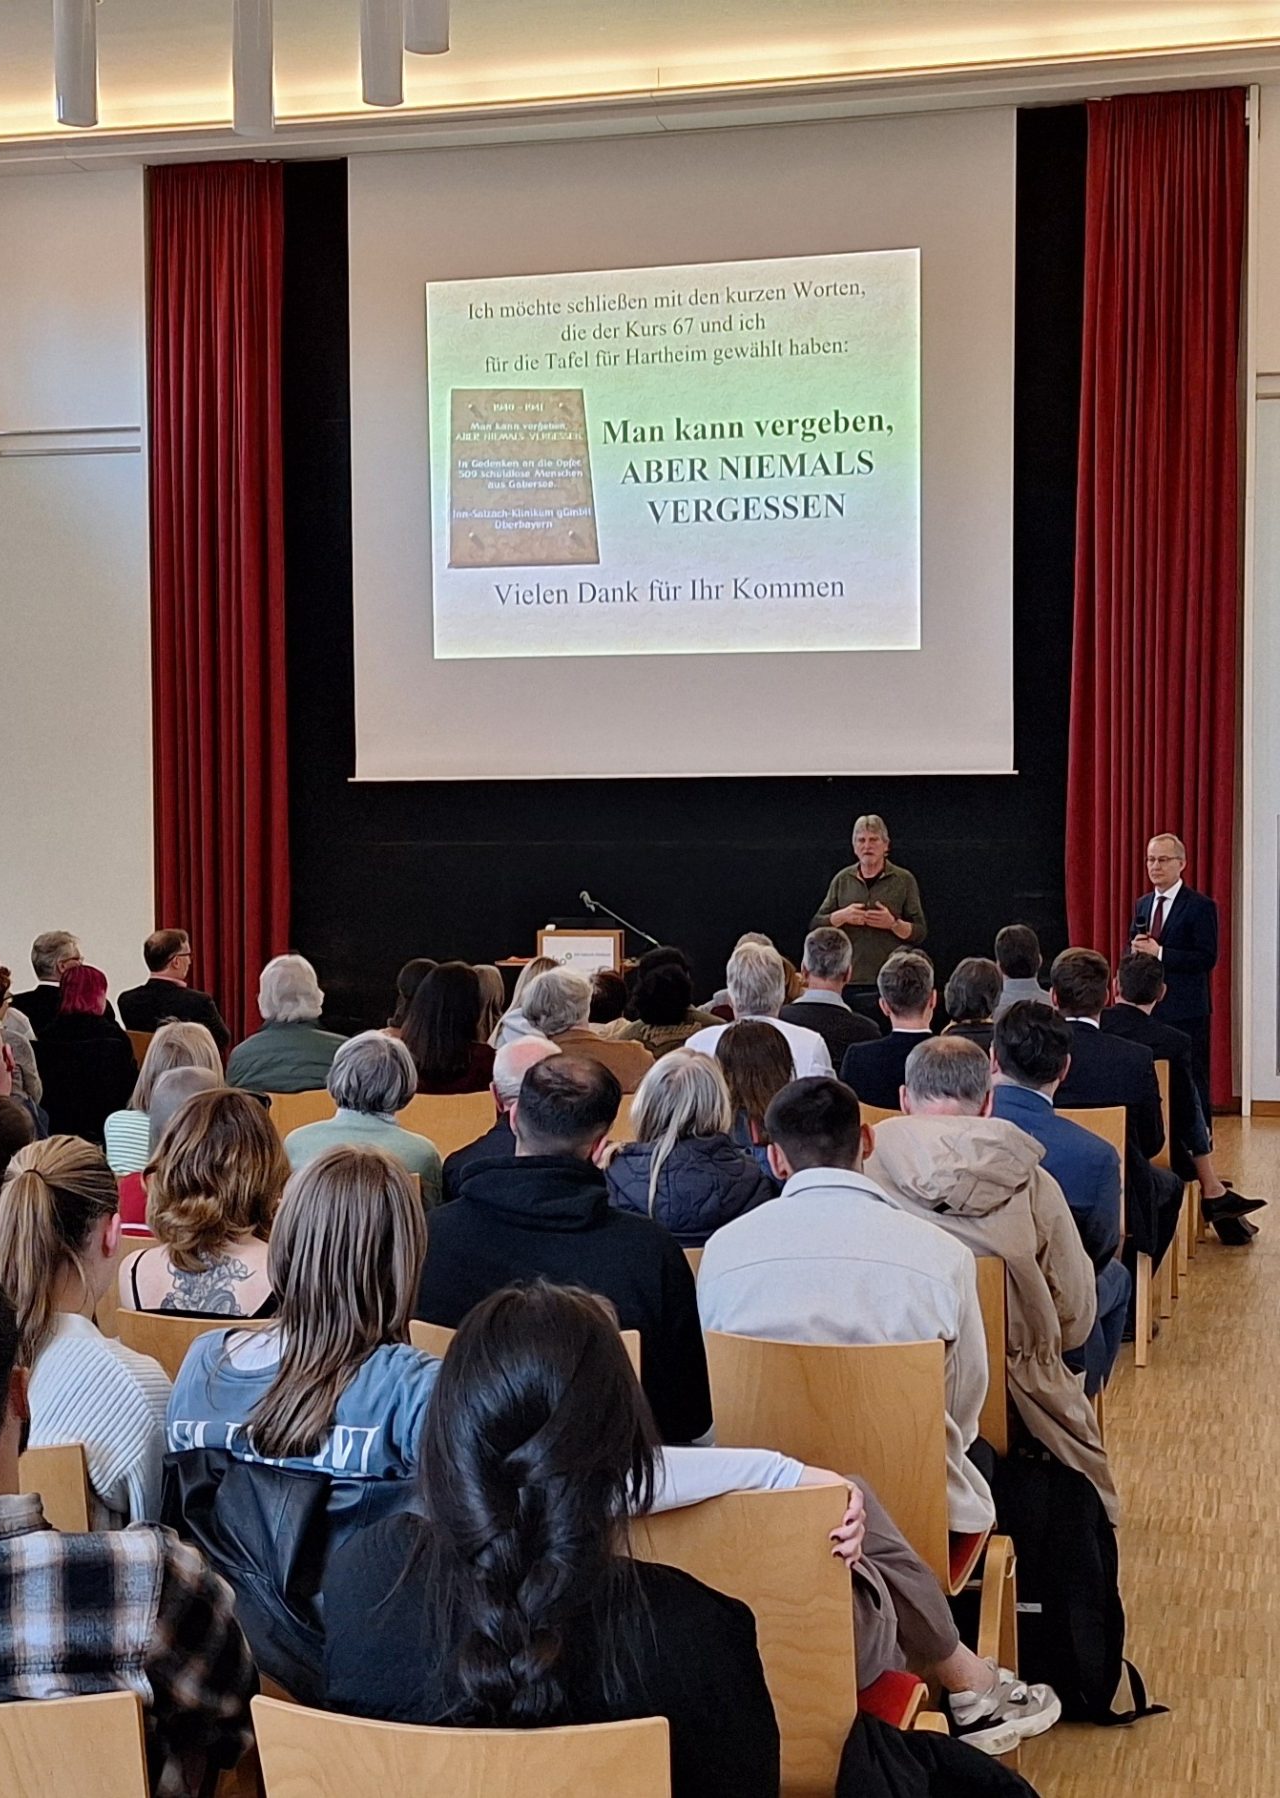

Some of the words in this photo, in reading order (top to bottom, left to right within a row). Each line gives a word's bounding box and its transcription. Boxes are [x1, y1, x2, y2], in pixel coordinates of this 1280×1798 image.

[468, 302, 494, 320] Ich
[500, 298, 561, 318] möchte
[567, 292, 647, 314] schließen
[654, 289, 683, 308] mit
[688, 288, 719, 306] den
[726, 286, 786, 304] kurzen
[793, 280, 866, 299] Worten,
[561, 323, 586, 342] die
[592, 322, 620, 339] der
[626, 320, 667, 338] Kurs
[673, 317, 694, 335] 67
[700, 314, 733, 333] und
[739, 312, 766, 331] ich
[485, 355, 508, 373] für
[514, 353, 540, 372] die
[545, 351, 589, 370] Tafel
[596, 349, 620, 367] für
[626, 345, 707, 365] Hartheim
[713, 339, 783, 366] gewählt
[789, 337, 849, 356] haben:
[602, 419, 664, 445] Man
[675, 417, 744, 442] kann
[754, 409, 894, 442] vergeben,
[471, 459, 519, 469] Gedenken
[537, 458, 553, 468] die
[534, 468, 584, 478] Menschen
[620, 457, 709, 485] ABER
[719, 450, 874, 481] NIEMALS
[647, 492, 847, 525] VERGESSEN
[494, 583, 569, 606] Vielen
[578, 580, 639, 604] Dank
[649, 579, 683, 602] für
[691, 578, 725, 601] Ihr
[733, 577, 845, 600] Kommen
